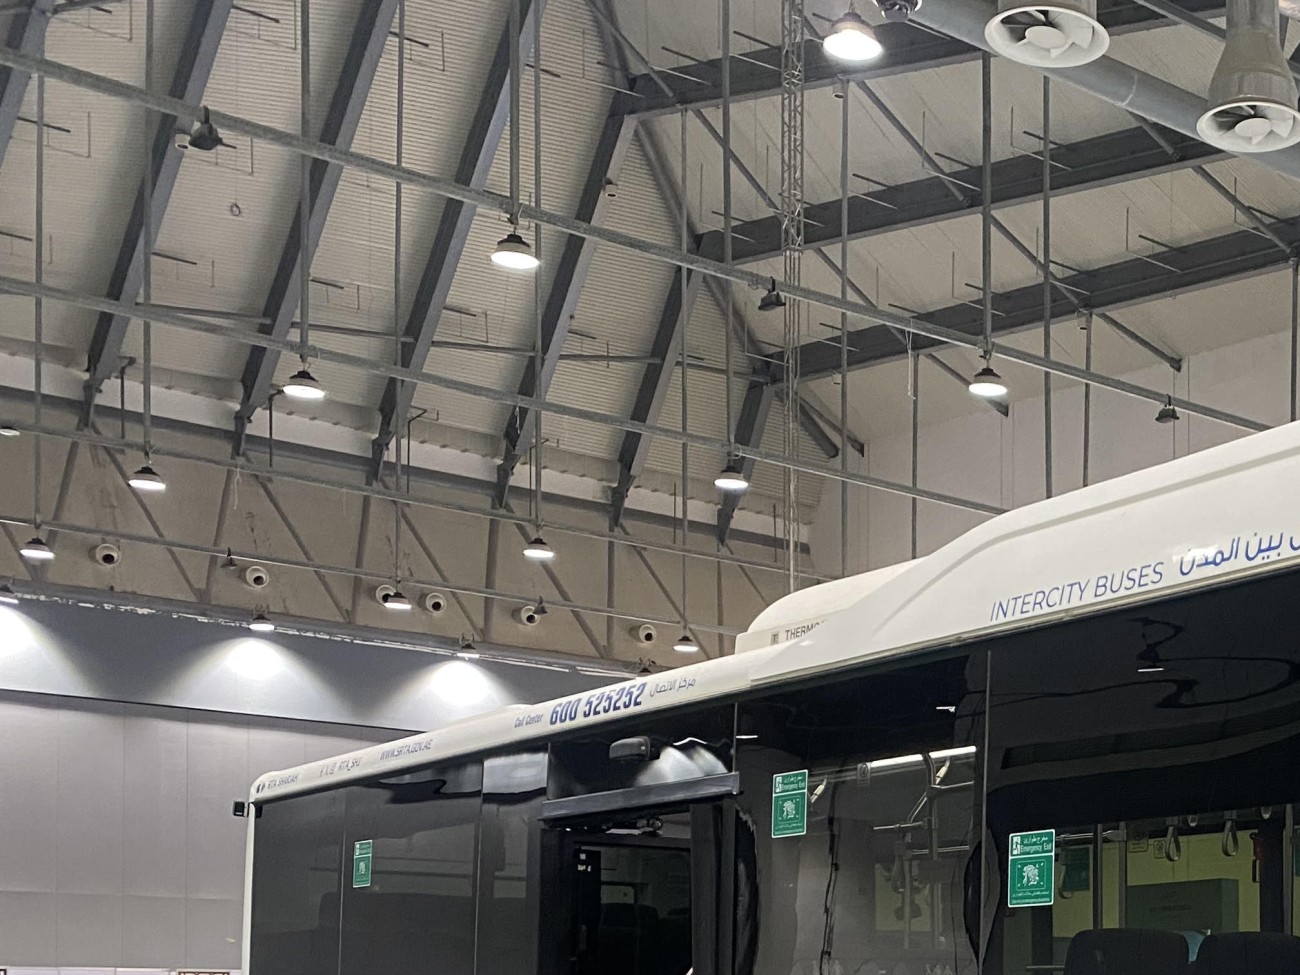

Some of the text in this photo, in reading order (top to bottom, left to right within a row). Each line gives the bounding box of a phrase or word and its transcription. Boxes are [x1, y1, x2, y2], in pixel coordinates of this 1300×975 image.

[1179, 537, 1241, 577] المدن
[1243, 531, 1284, 561] بين
[989, 561, 1165, 622] INTERCITY BUSES
[550, 682, 648, 726] 600 525252
[1021, 843, 1052, 854] Emergency Exit
